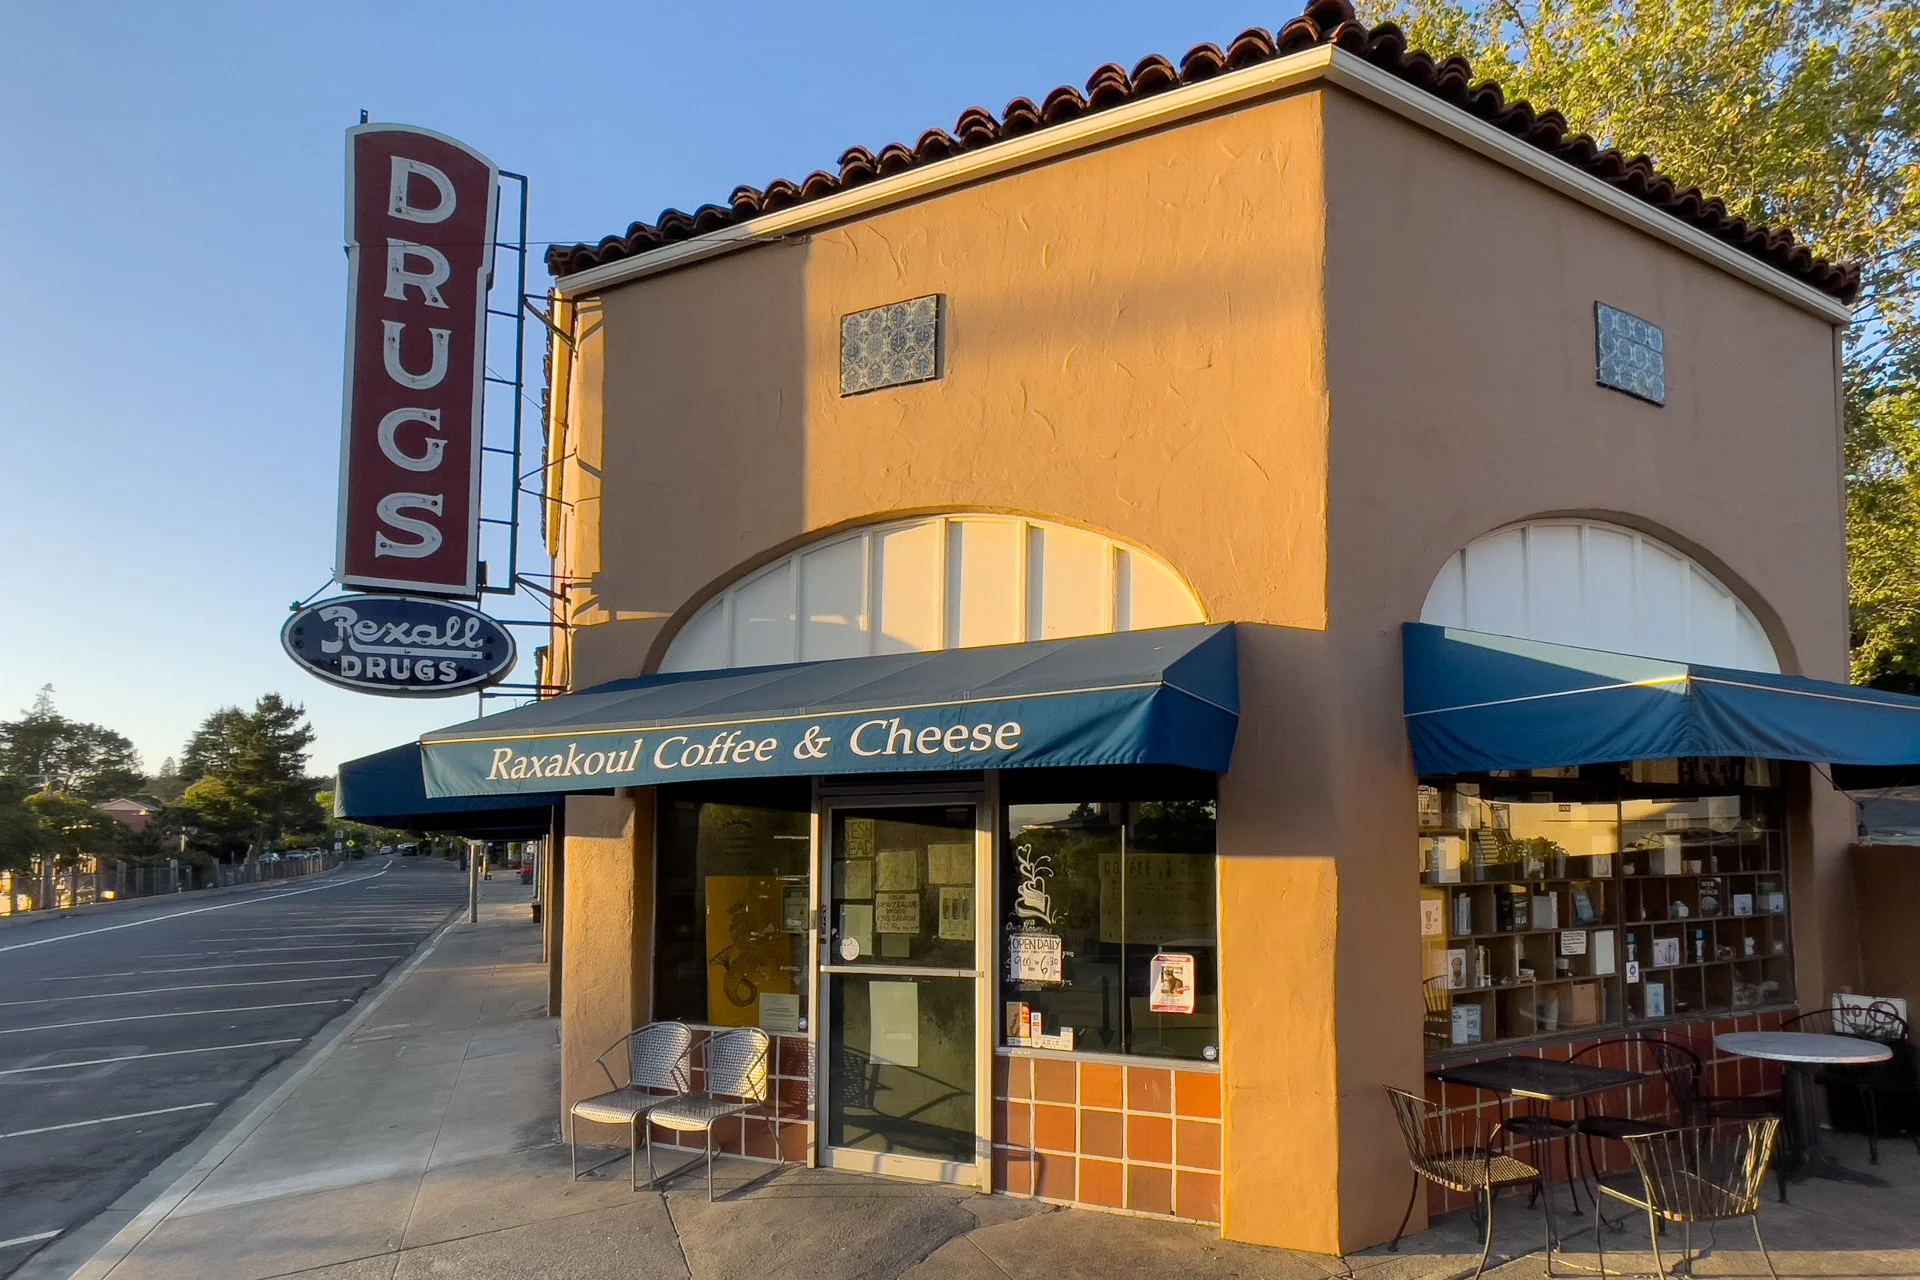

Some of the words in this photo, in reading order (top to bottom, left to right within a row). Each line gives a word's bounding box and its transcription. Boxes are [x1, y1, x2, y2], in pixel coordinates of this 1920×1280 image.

[375, 155, 457, 558] DRUGS
[318, 606, 483, 656] Rexall
[341, 656, 457, 681] DRUGS
[486, 738, 644, 781] Raxakoul
[653, 730, 778, 770] Coffee
[793, 725, 831, 760] &
[850, 717, 1022, 757] Cheese
[1012, 938, 1036, 950] OPEN
[1037, 939, 1061, 951] DAILY
